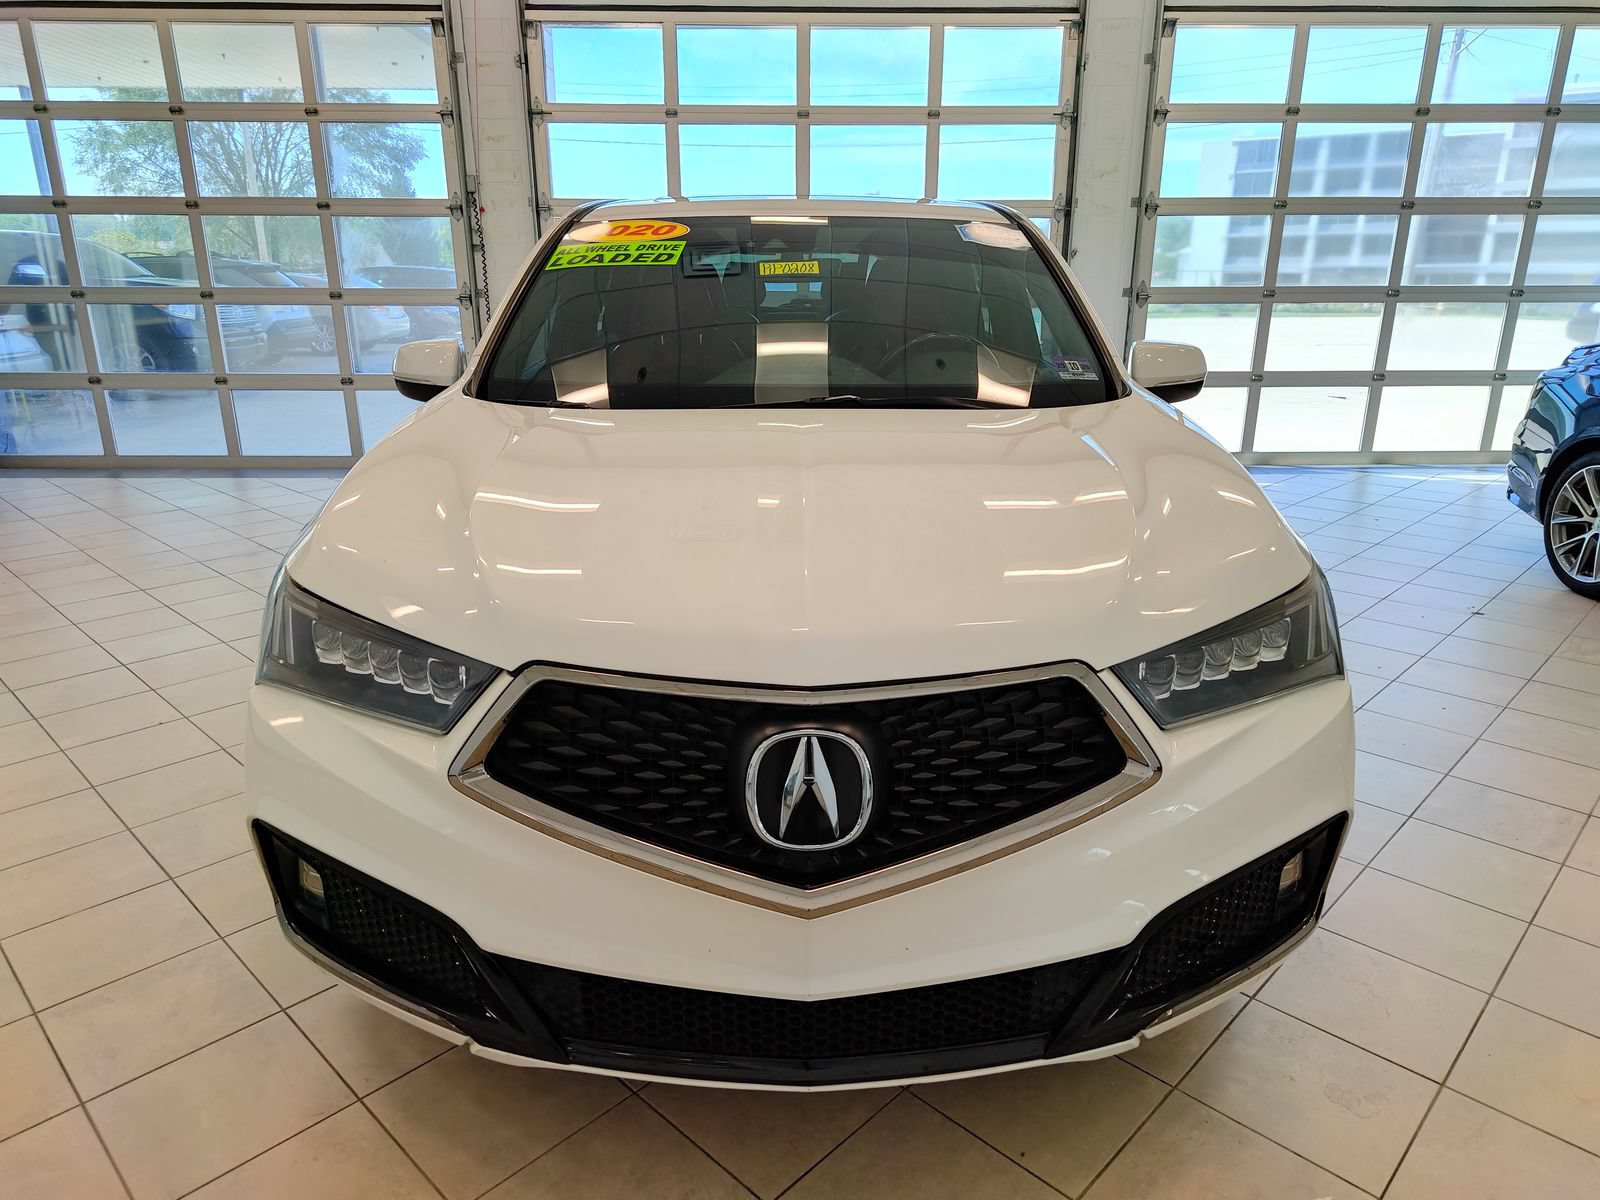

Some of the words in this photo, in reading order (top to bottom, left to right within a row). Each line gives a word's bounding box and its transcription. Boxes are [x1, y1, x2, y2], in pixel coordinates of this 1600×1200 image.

[600, 224, 678, 237] 020
[557, 247, 581, 256] ALL
[585, 244, 630, 253] WHEEL
[635, 243, 682, 252] DRIVE
[548, 252, 675, 267] LOADED
[1068, 362, 1079, 370] 10
